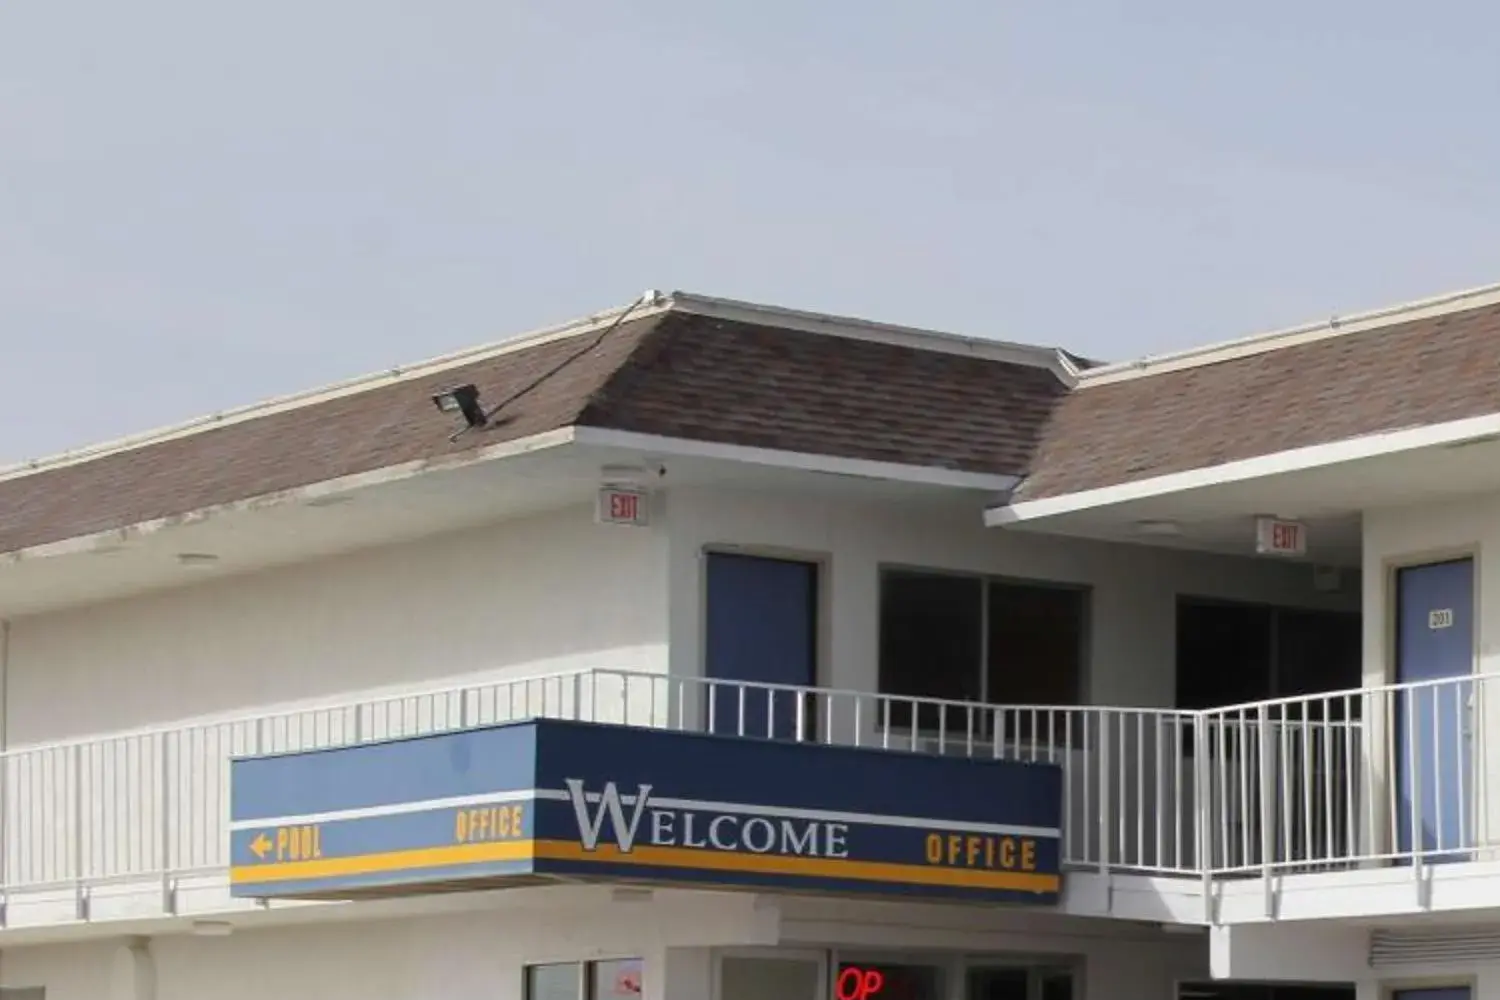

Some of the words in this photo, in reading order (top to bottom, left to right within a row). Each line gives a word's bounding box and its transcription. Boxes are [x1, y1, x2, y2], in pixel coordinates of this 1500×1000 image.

[455, 805, 524, 842] OFFICE
[564, 777, 850, 858] WELCOME
[276, 824, 322, 861] POOL
[926, 832, 1037, 870] OFFICE
